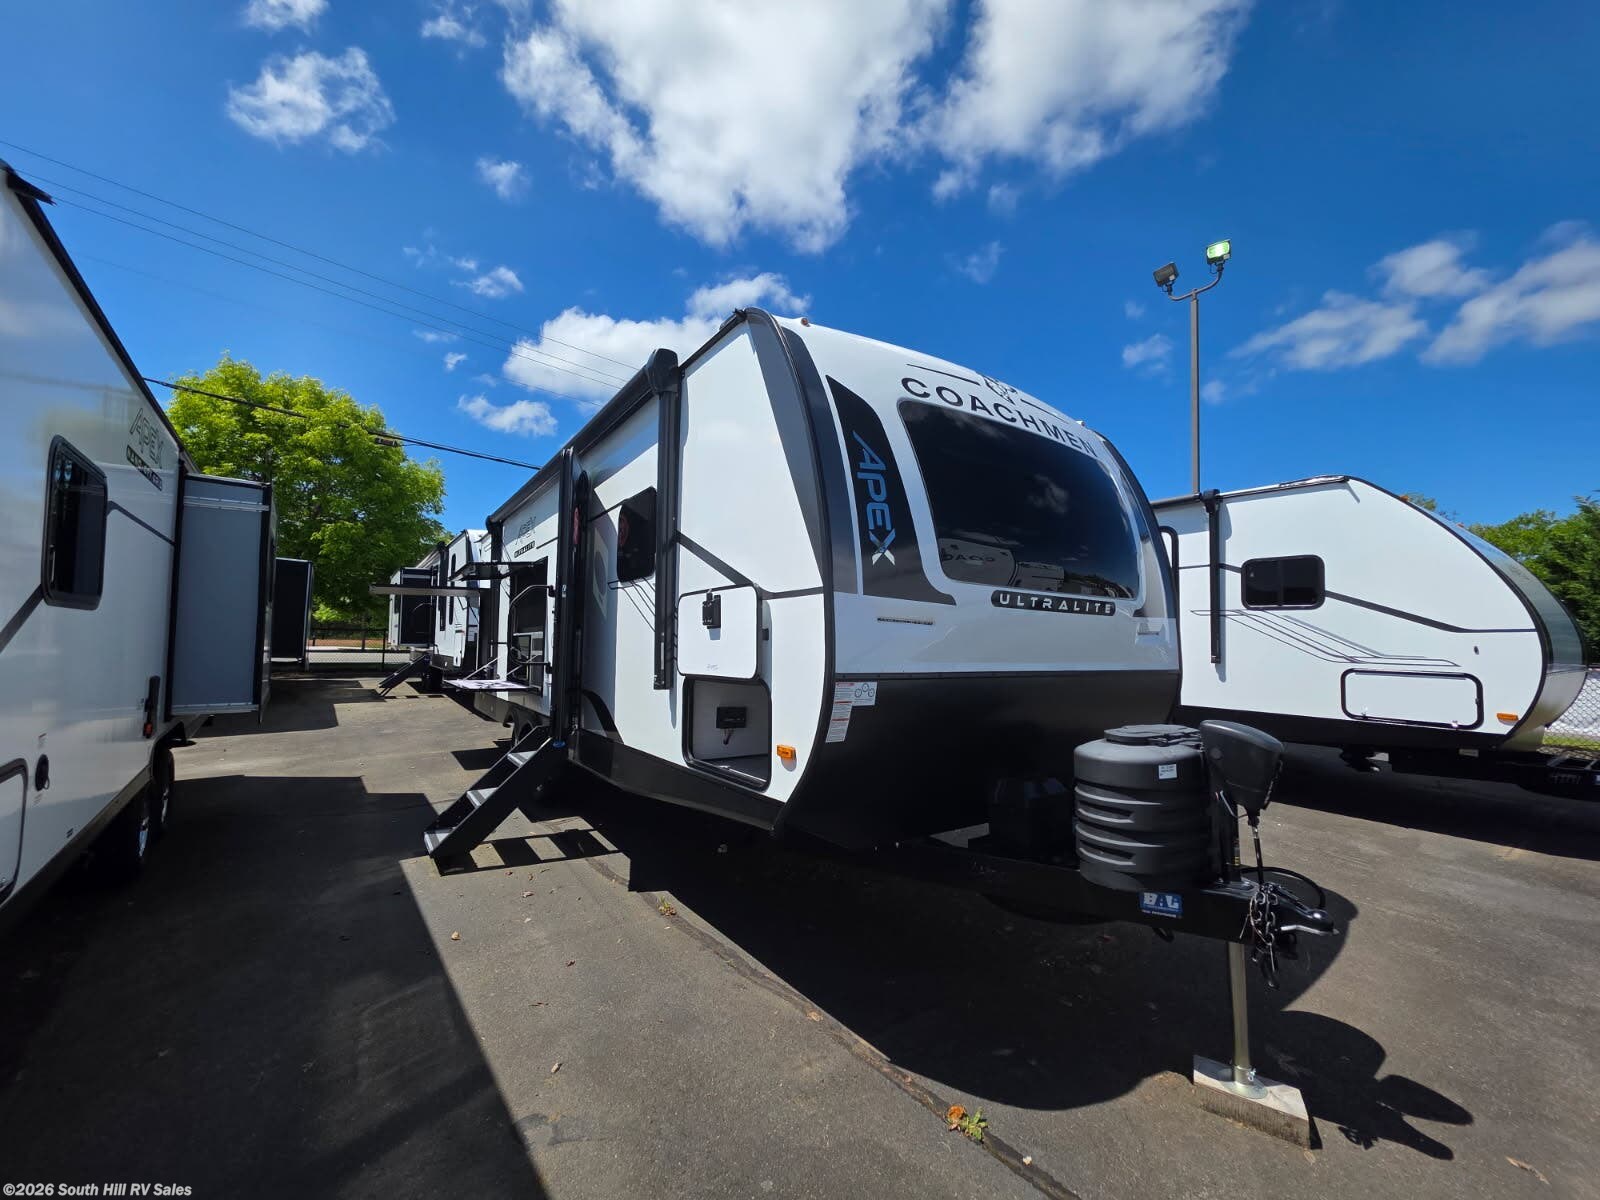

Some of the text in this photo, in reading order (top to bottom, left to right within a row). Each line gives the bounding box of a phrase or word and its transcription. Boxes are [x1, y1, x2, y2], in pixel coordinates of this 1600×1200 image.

[901, 377, 1098, 458] COACHMEN
[852, 430, 896, 566] APEX
[999, 593, 1113, 614] ULTRALITE
